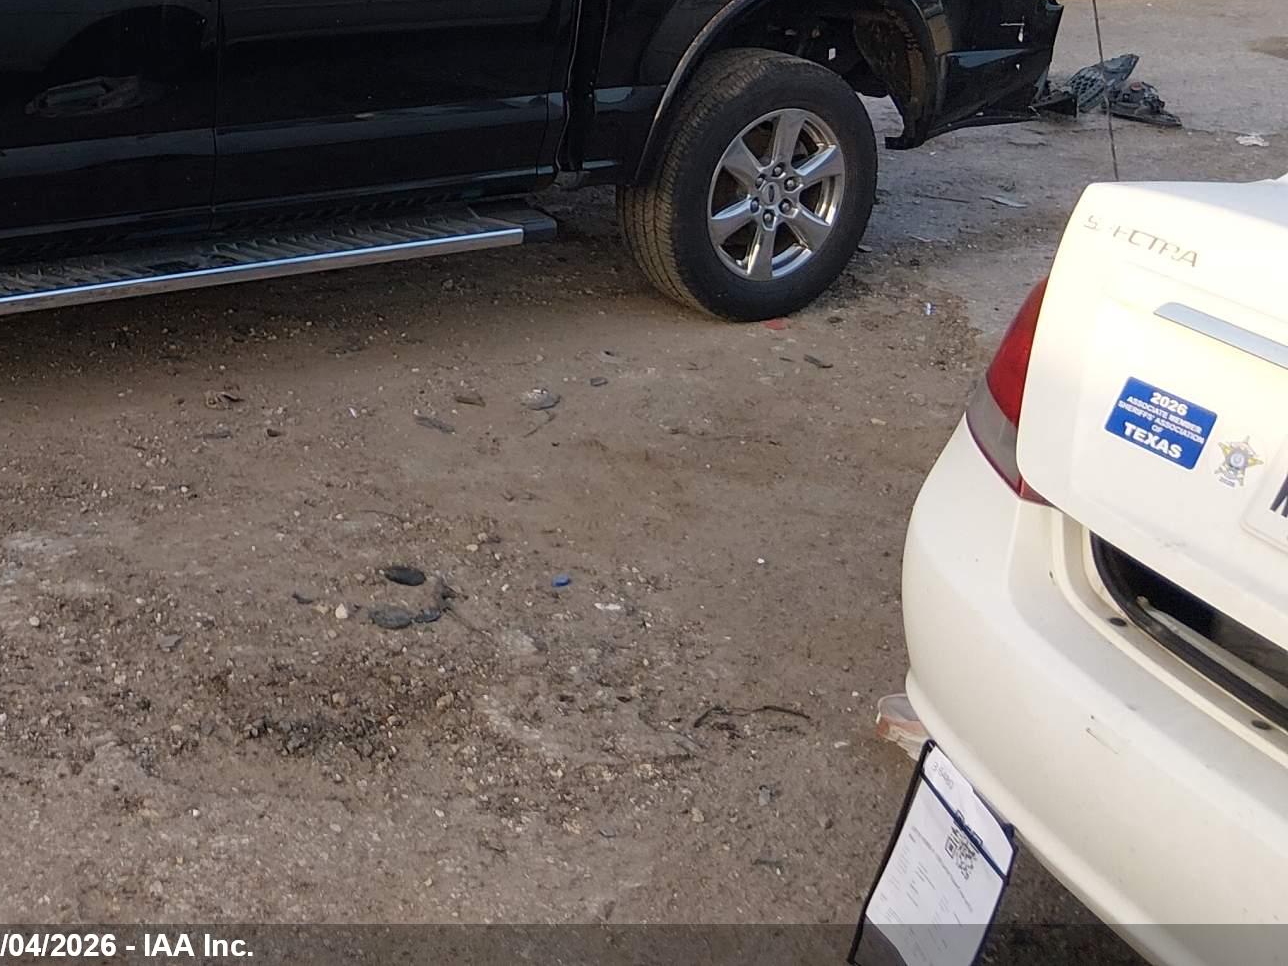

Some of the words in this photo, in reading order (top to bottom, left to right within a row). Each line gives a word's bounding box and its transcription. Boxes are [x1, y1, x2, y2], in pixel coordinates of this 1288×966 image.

[1127, 396, 1169, 419] ASSOCIATE
[1168, 414, 1202, 434] MEMBER
[1150, 392, 1188, 416] 2026
[1124, 421, 1182, 458] TEXAS
[1151, 424, 1165, 433] OF
[1154, 417, 1205, 444] ASSOCIATION
